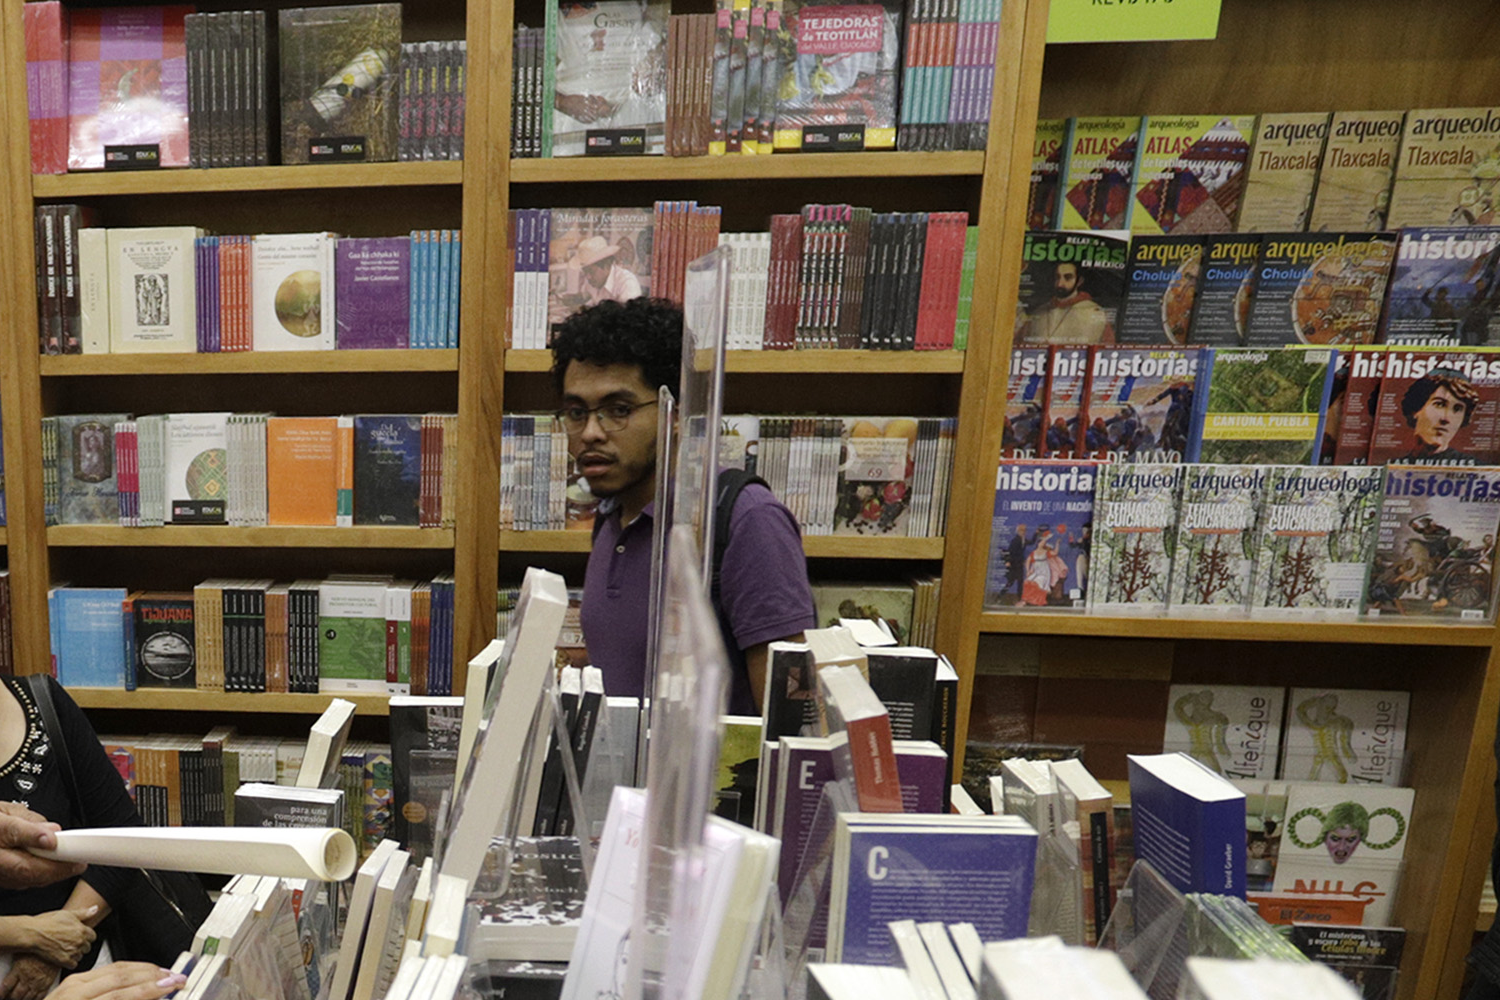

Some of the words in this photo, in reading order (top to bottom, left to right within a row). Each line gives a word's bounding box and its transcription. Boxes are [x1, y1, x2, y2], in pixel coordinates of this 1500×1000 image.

[593, 12, 635, 29] Gasas
[803, 16, 879, 29] TEJEDORAS
[802, 33, 813, 41] de
[816, 29, 878, 41] TEOTITLÁN
[1075, 137, 1120, 156] ATLAS
[1146, 136, 1193, 154] ATLAS
[1258, 150, 1319, 171] Tlaxcala
[1329, 148, 1391, 168] Tlaxcala
[1407, 145, 1474, 166] Tlaxcala
[1135, 451, 1182, 464] MAYO
[1275, 471, 1381, 497] arqueología
[1010, 501, 1042, 512] INVENTO
[141, 608, 193, 620] TIJUANA
[866, 846, 889, 880] C
[1280, 910, 1292, 921] El
